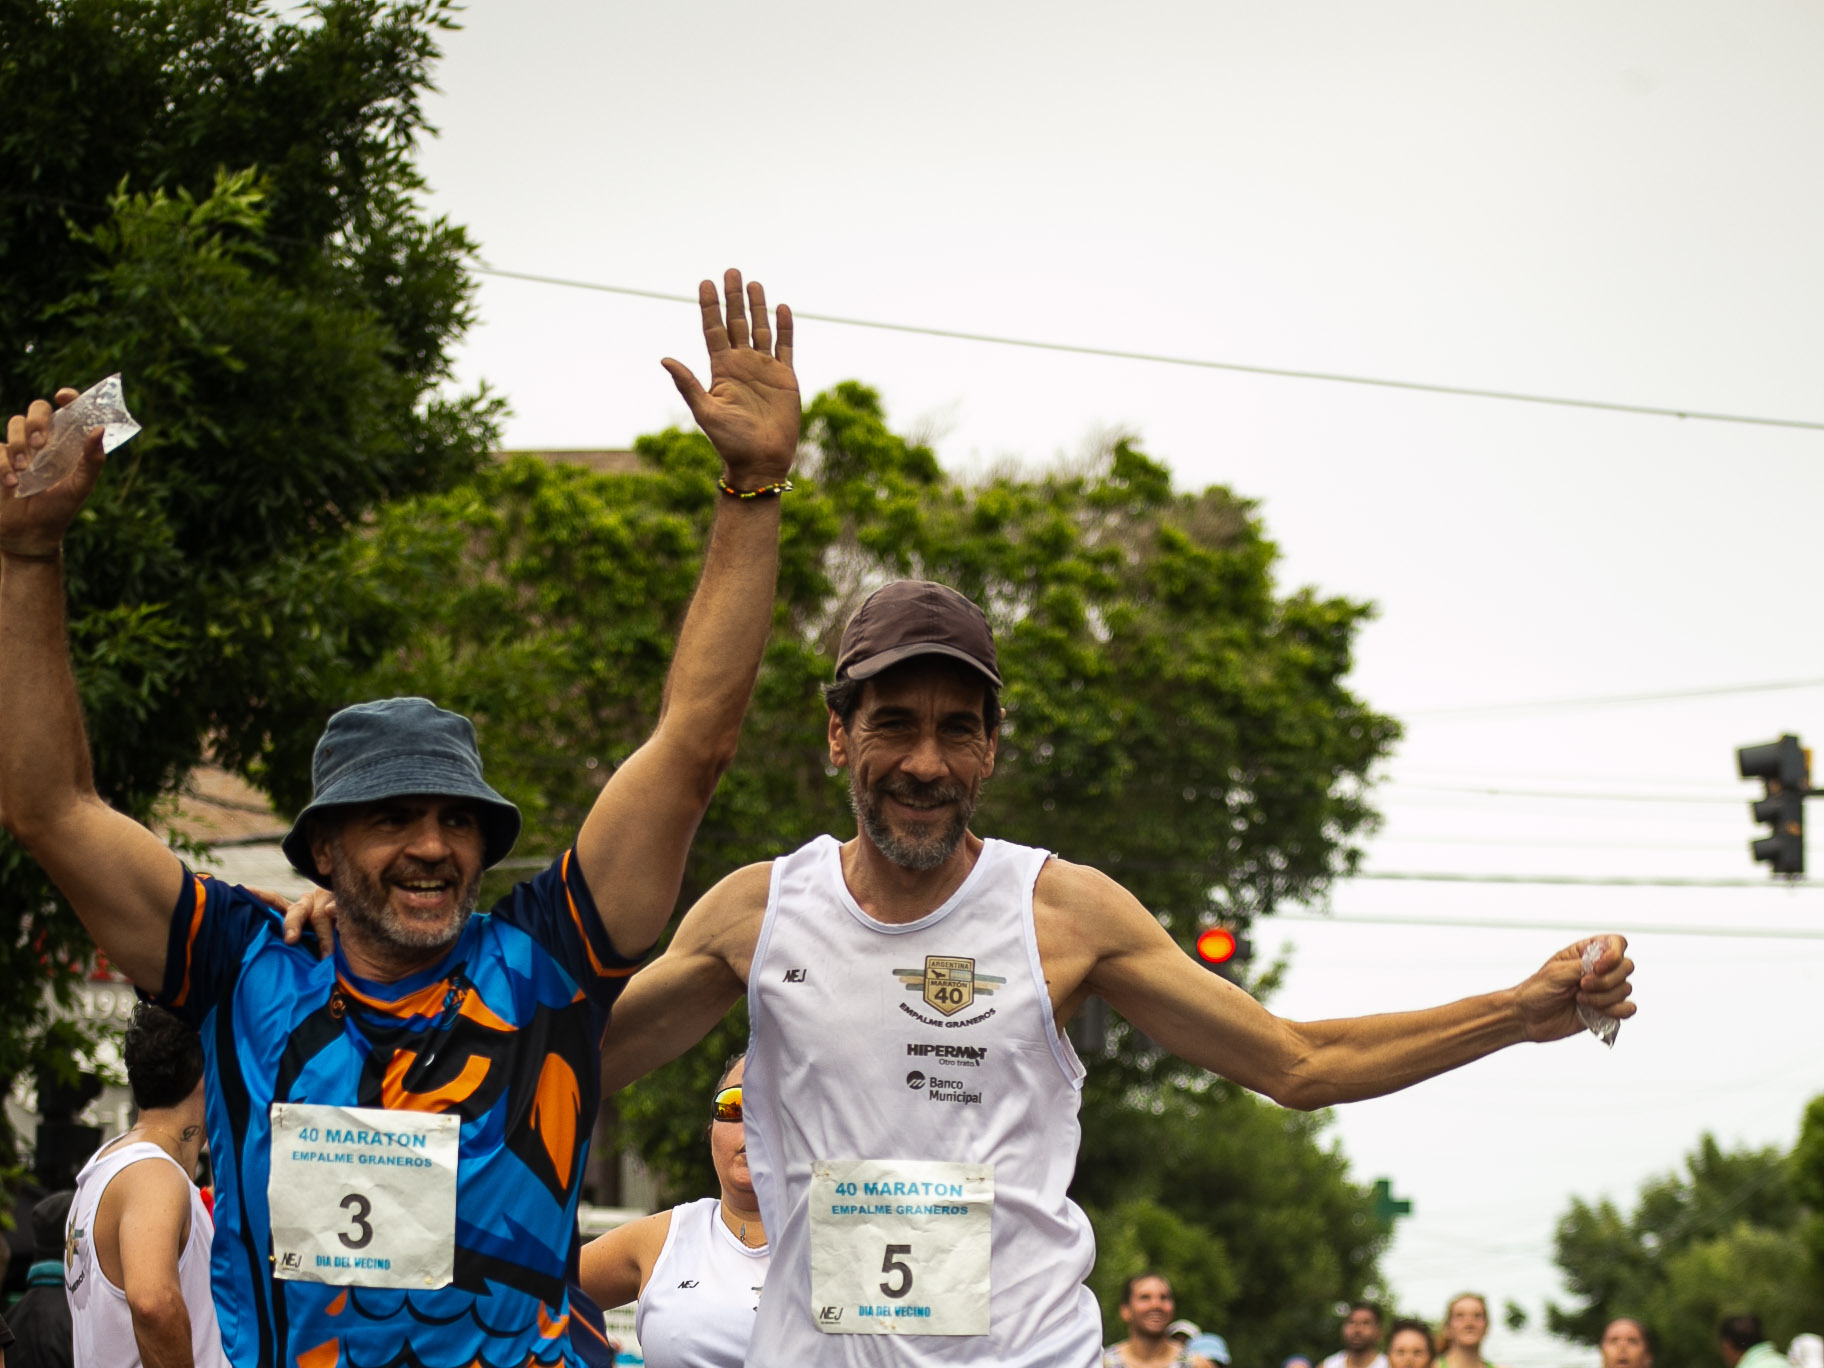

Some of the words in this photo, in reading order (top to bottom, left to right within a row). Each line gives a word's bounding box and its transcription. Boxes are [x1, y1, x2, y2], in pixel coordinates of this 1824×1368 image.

[931, 961, 969, 969] ARGENTINA
[931, 980, 967, 988] MARATÓN
[934, 987, 963, 1004] 40
[899, 1002, 943, 1028] EMPALME
[945, 1008, 996, 1028] GRANEROS
[939, 1058, 955, 1066] Otro
[929, 1077, 963, 1089] Banco
[929, 1090, 982, 1105] Municipal
[299, 1128, 319, 1142] 40
[326, 1129, 426, 1147] MARATON
[292, 1151, 354, 1163] EMPALME
[358, 1154, 432, 1168] GRANEROS
[835, 1182, 857, 1196] 40
[863, 1182, 963, 1197] MARATON
[832, 1205, 892, 1214] EMPALME
[896, 1205, 968, 1215] GRANEROS
[337, 1193, 374, 1250] 3
[316, 1255, 331, 1266] DIA
[334, 1256, 350, 1267] DEL
[354, 1258, 390, 1270] VECINO
[879, 1244, 913, 1299] 5
[859, 1305, 873, 1316] DIA
[876, 1306, 891, 1317] DEL
[895, 1306, 931, 1317] VECINO
